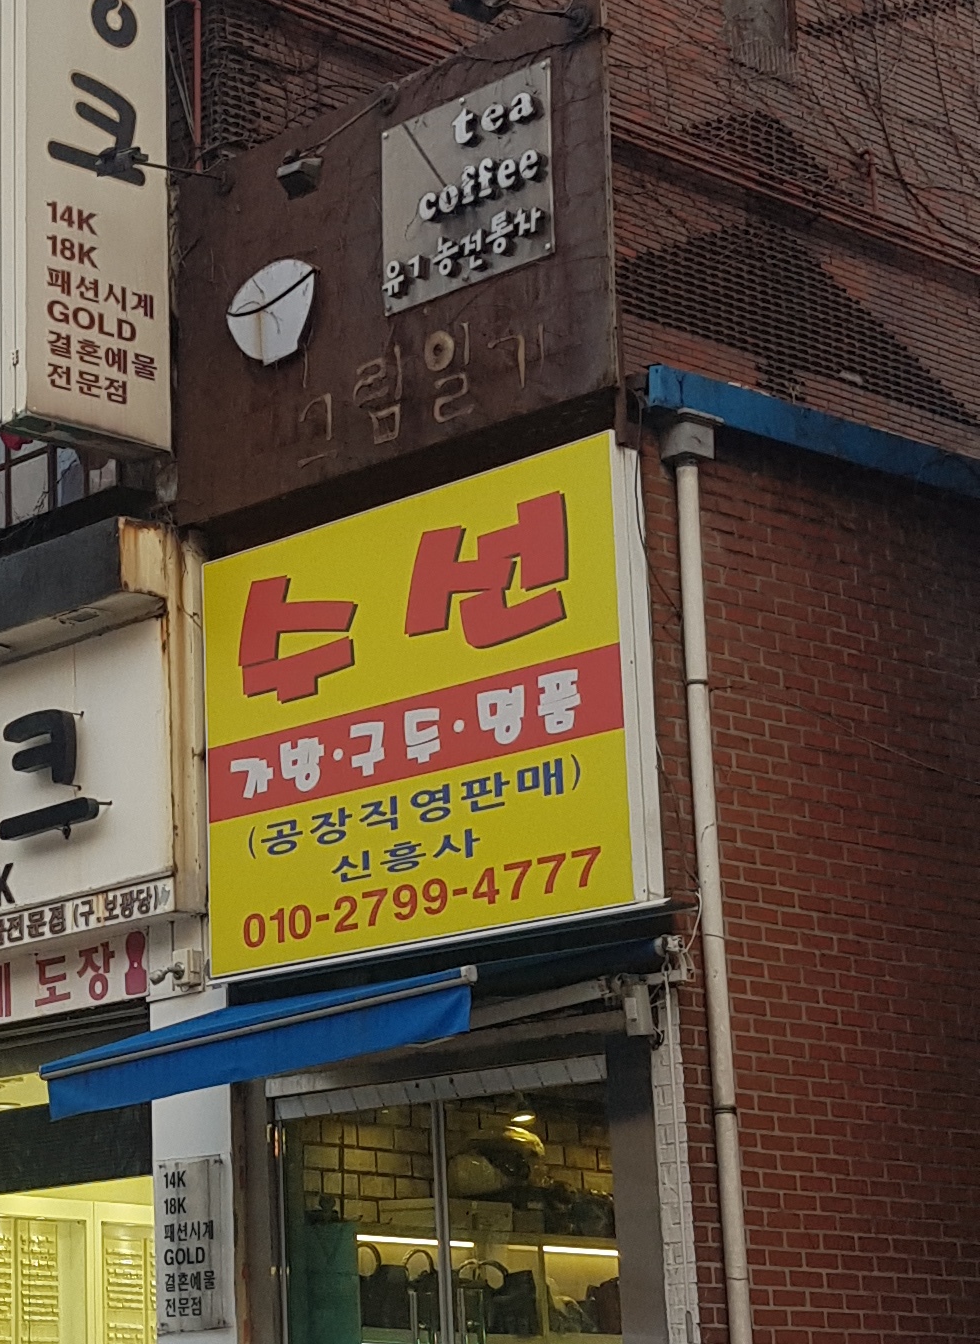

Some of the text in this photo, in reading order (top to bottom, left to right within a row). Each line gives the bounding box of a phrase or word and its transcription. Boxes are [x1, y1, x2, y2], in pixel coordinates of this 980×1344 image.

[452, 90, 538, 146] tea
[420, 148, 542, 223] coffee
[46, 200, 98, 237] 14K
[46, 234, 100, 271] 18K
[46, 265, 156, 320] 패션시계
[46, 299, 138, 343] GOLD
[46, 329, 158, 381] 결혼예물
[46, 362, 129, 406] 전문점
[331, 828, 482, 885] 신흥사
[242, 845, 603, 949] 010-2799-4777
[34, 941, 116, 1008] 도장
[163, 1170, 187, 1189] 14K
[163, 1196, 187, 1215] 18K
[163, 1219, 214, 1242] 패션시계
[163, 1246, 206, 1266] GOLD
[164, 1270, 216, 1293] 결혼예물
[165, 1296, 202, 1318] 전문점
